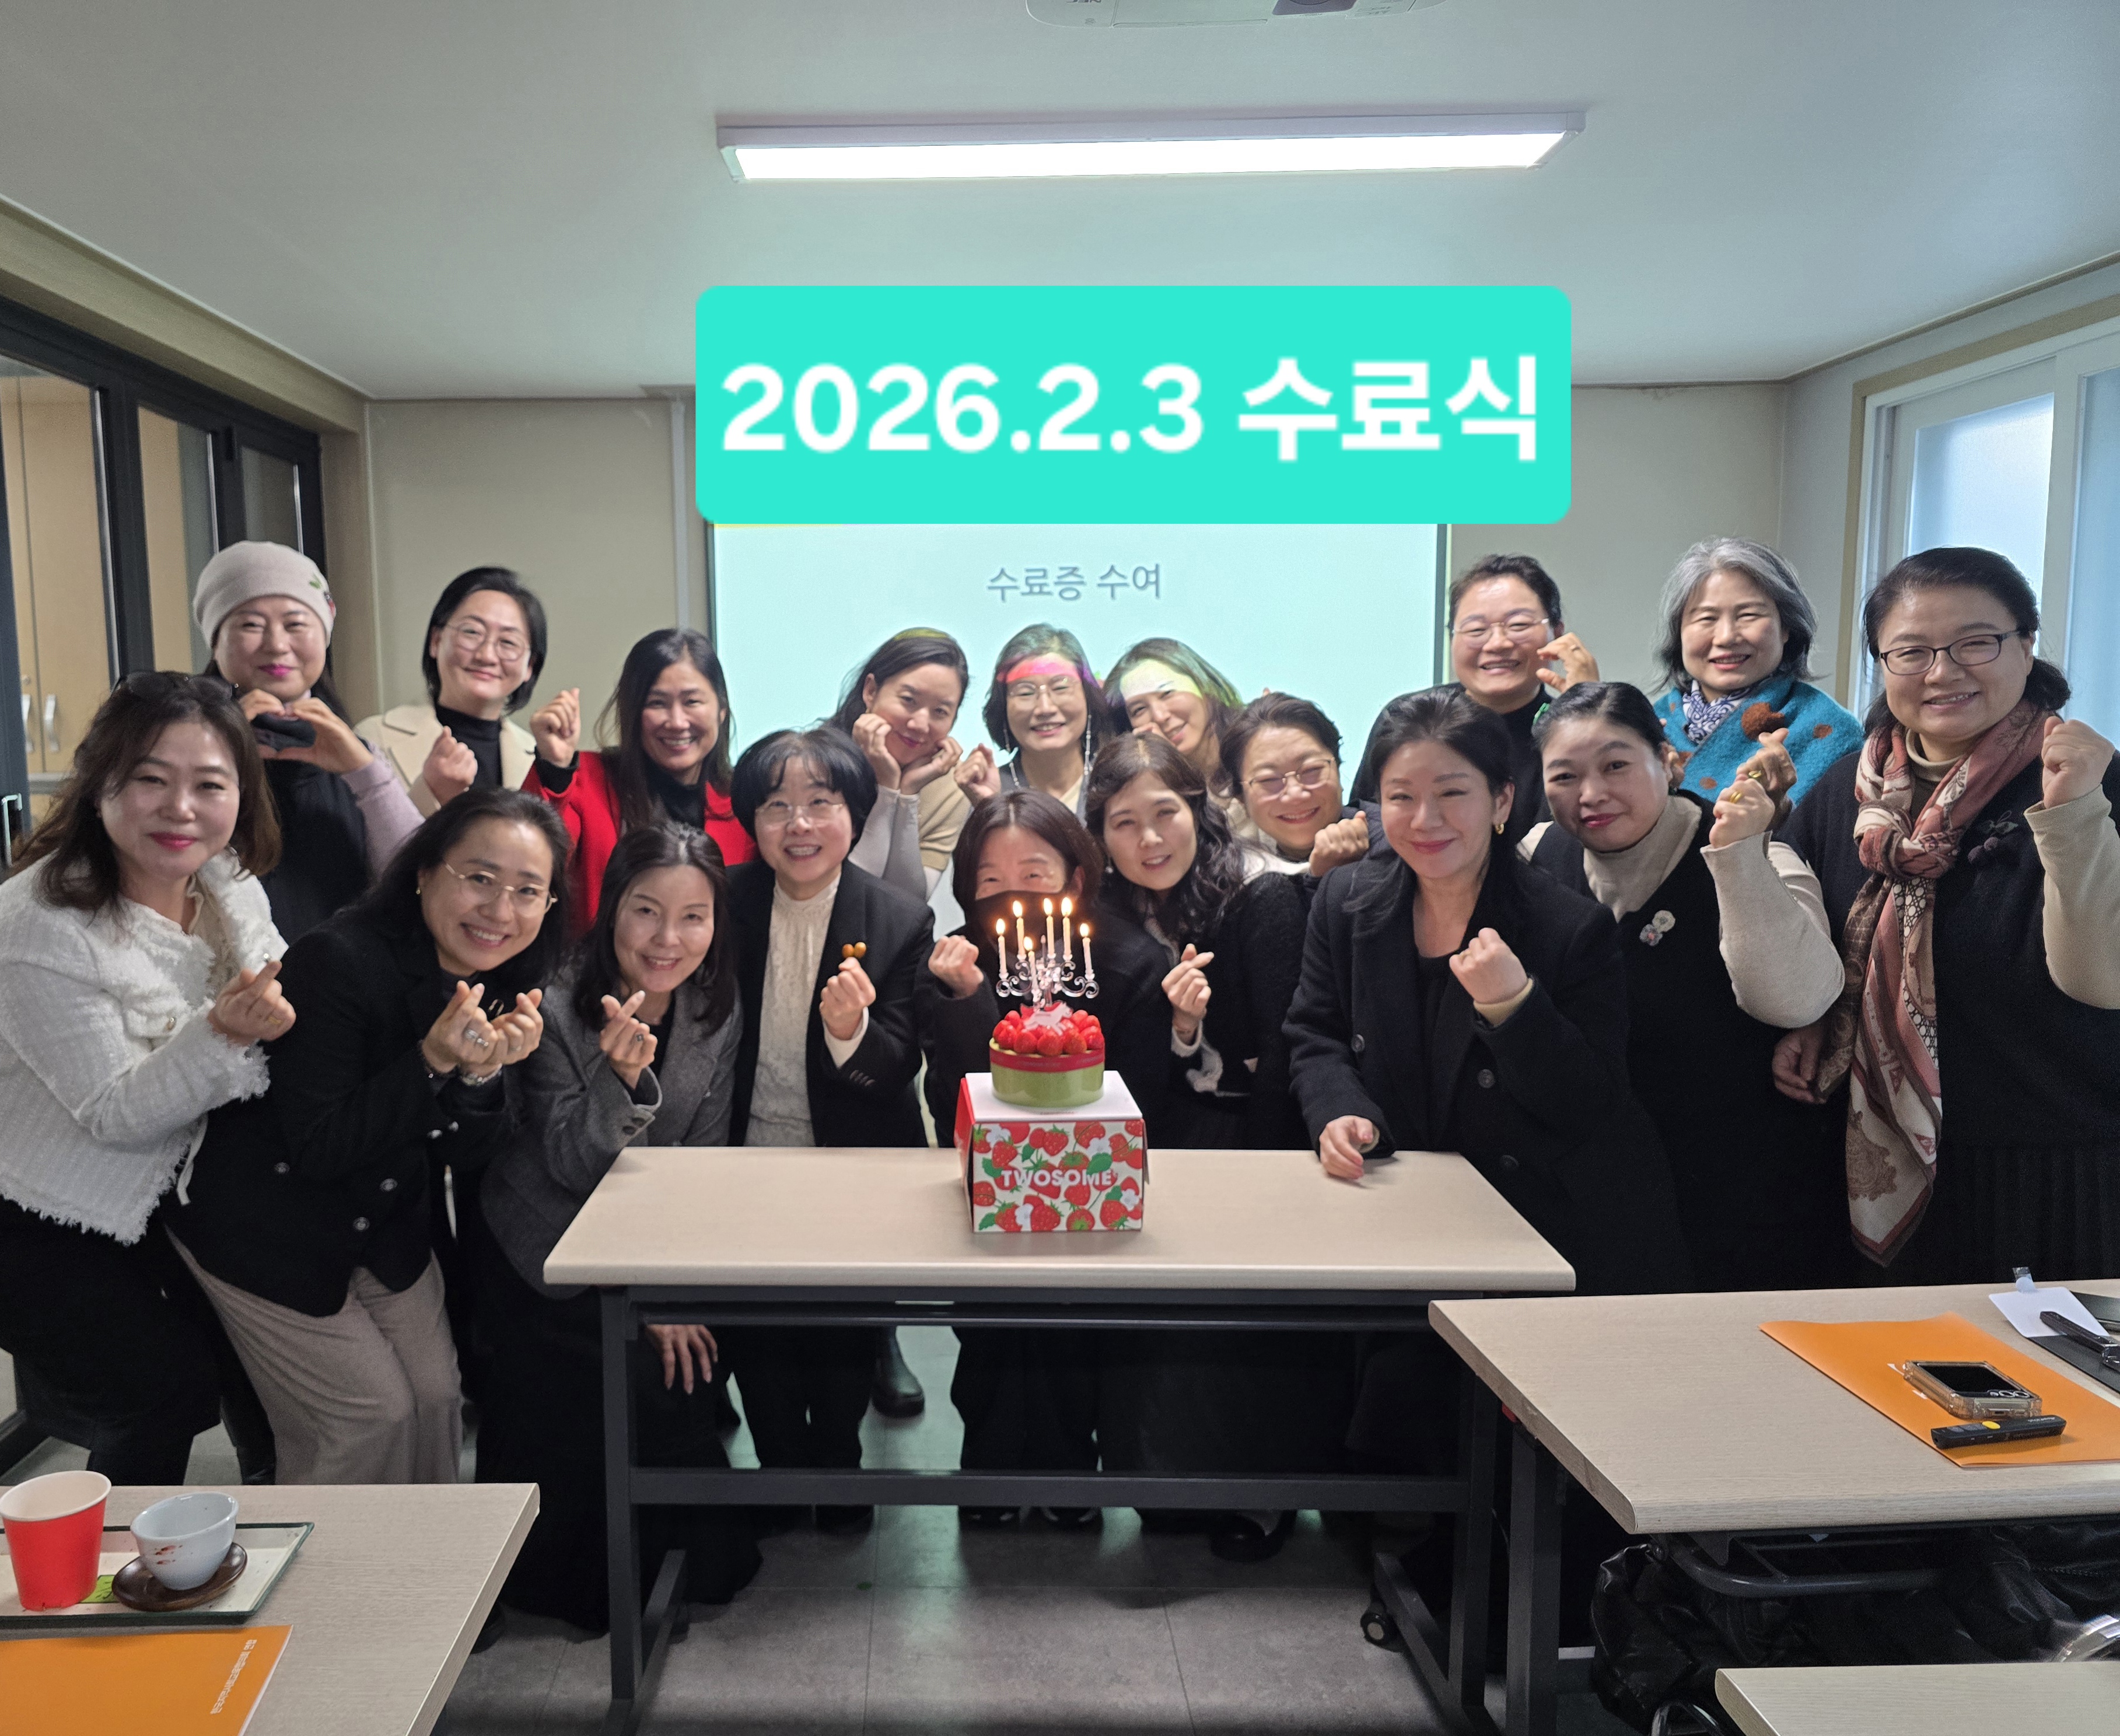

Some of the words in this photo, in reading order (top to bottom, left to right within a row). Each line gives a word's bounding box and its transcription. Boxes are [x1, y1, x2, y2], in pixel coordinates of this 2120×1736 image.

[986, 565, 1087, 603] 수료증
[1096, 563, 1161, 600] 수여
[1000, 1169, 1112, 1186] TWOSOME
